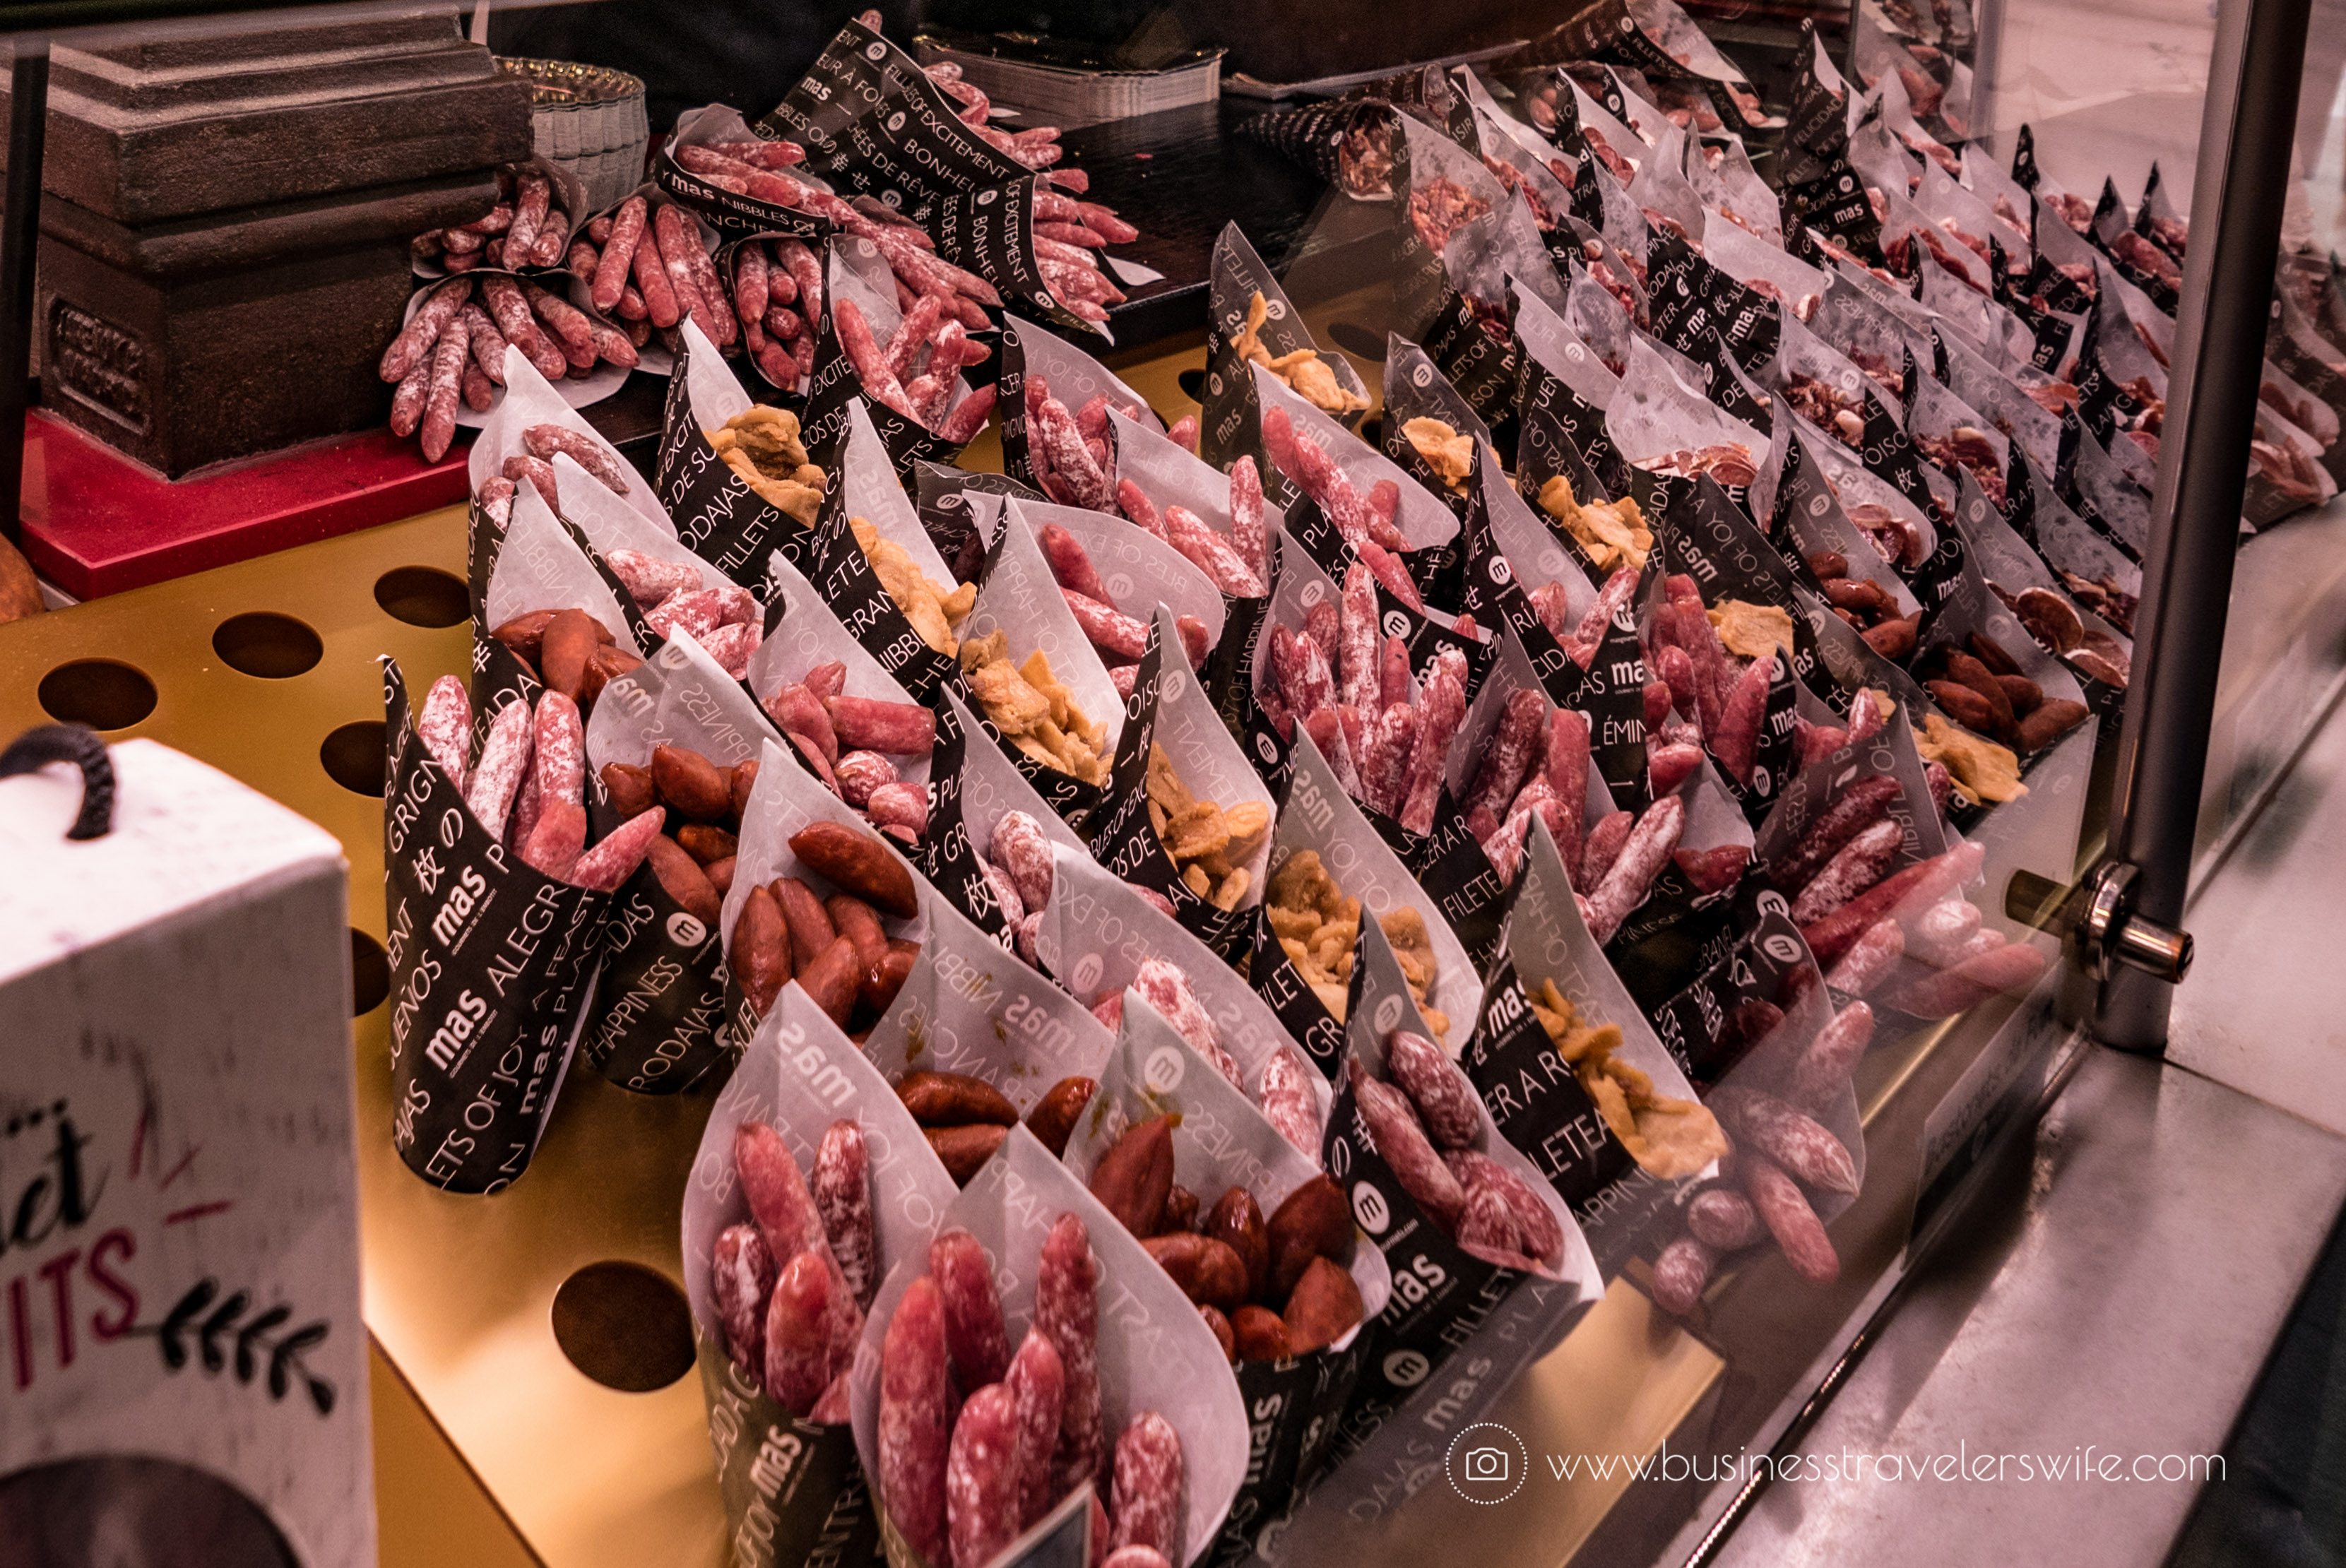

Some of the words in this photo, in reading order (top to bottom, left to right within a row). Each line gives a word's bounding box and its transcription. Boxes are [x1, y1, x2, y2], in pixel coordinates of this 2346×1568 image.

[800, 76, 832, 102] mas
[921, 110, 1011, 179] EXCITEMENT
[672, 174, 715, 200] mas
[1833, 202, 1864, 225] mas
[1216, 407, 1243, 446] mas
[430, 864, 487, 948] mas
[486, 882, 569, 998] ALEGR
[425, 988, 488, 1071] mas
[519, 1023, 558, 1115] mas
[464, 1083, 503, 1131] OF
[492, 1024, 528, 1088] JOY
[6, 1227, 139, 1392] ITS
